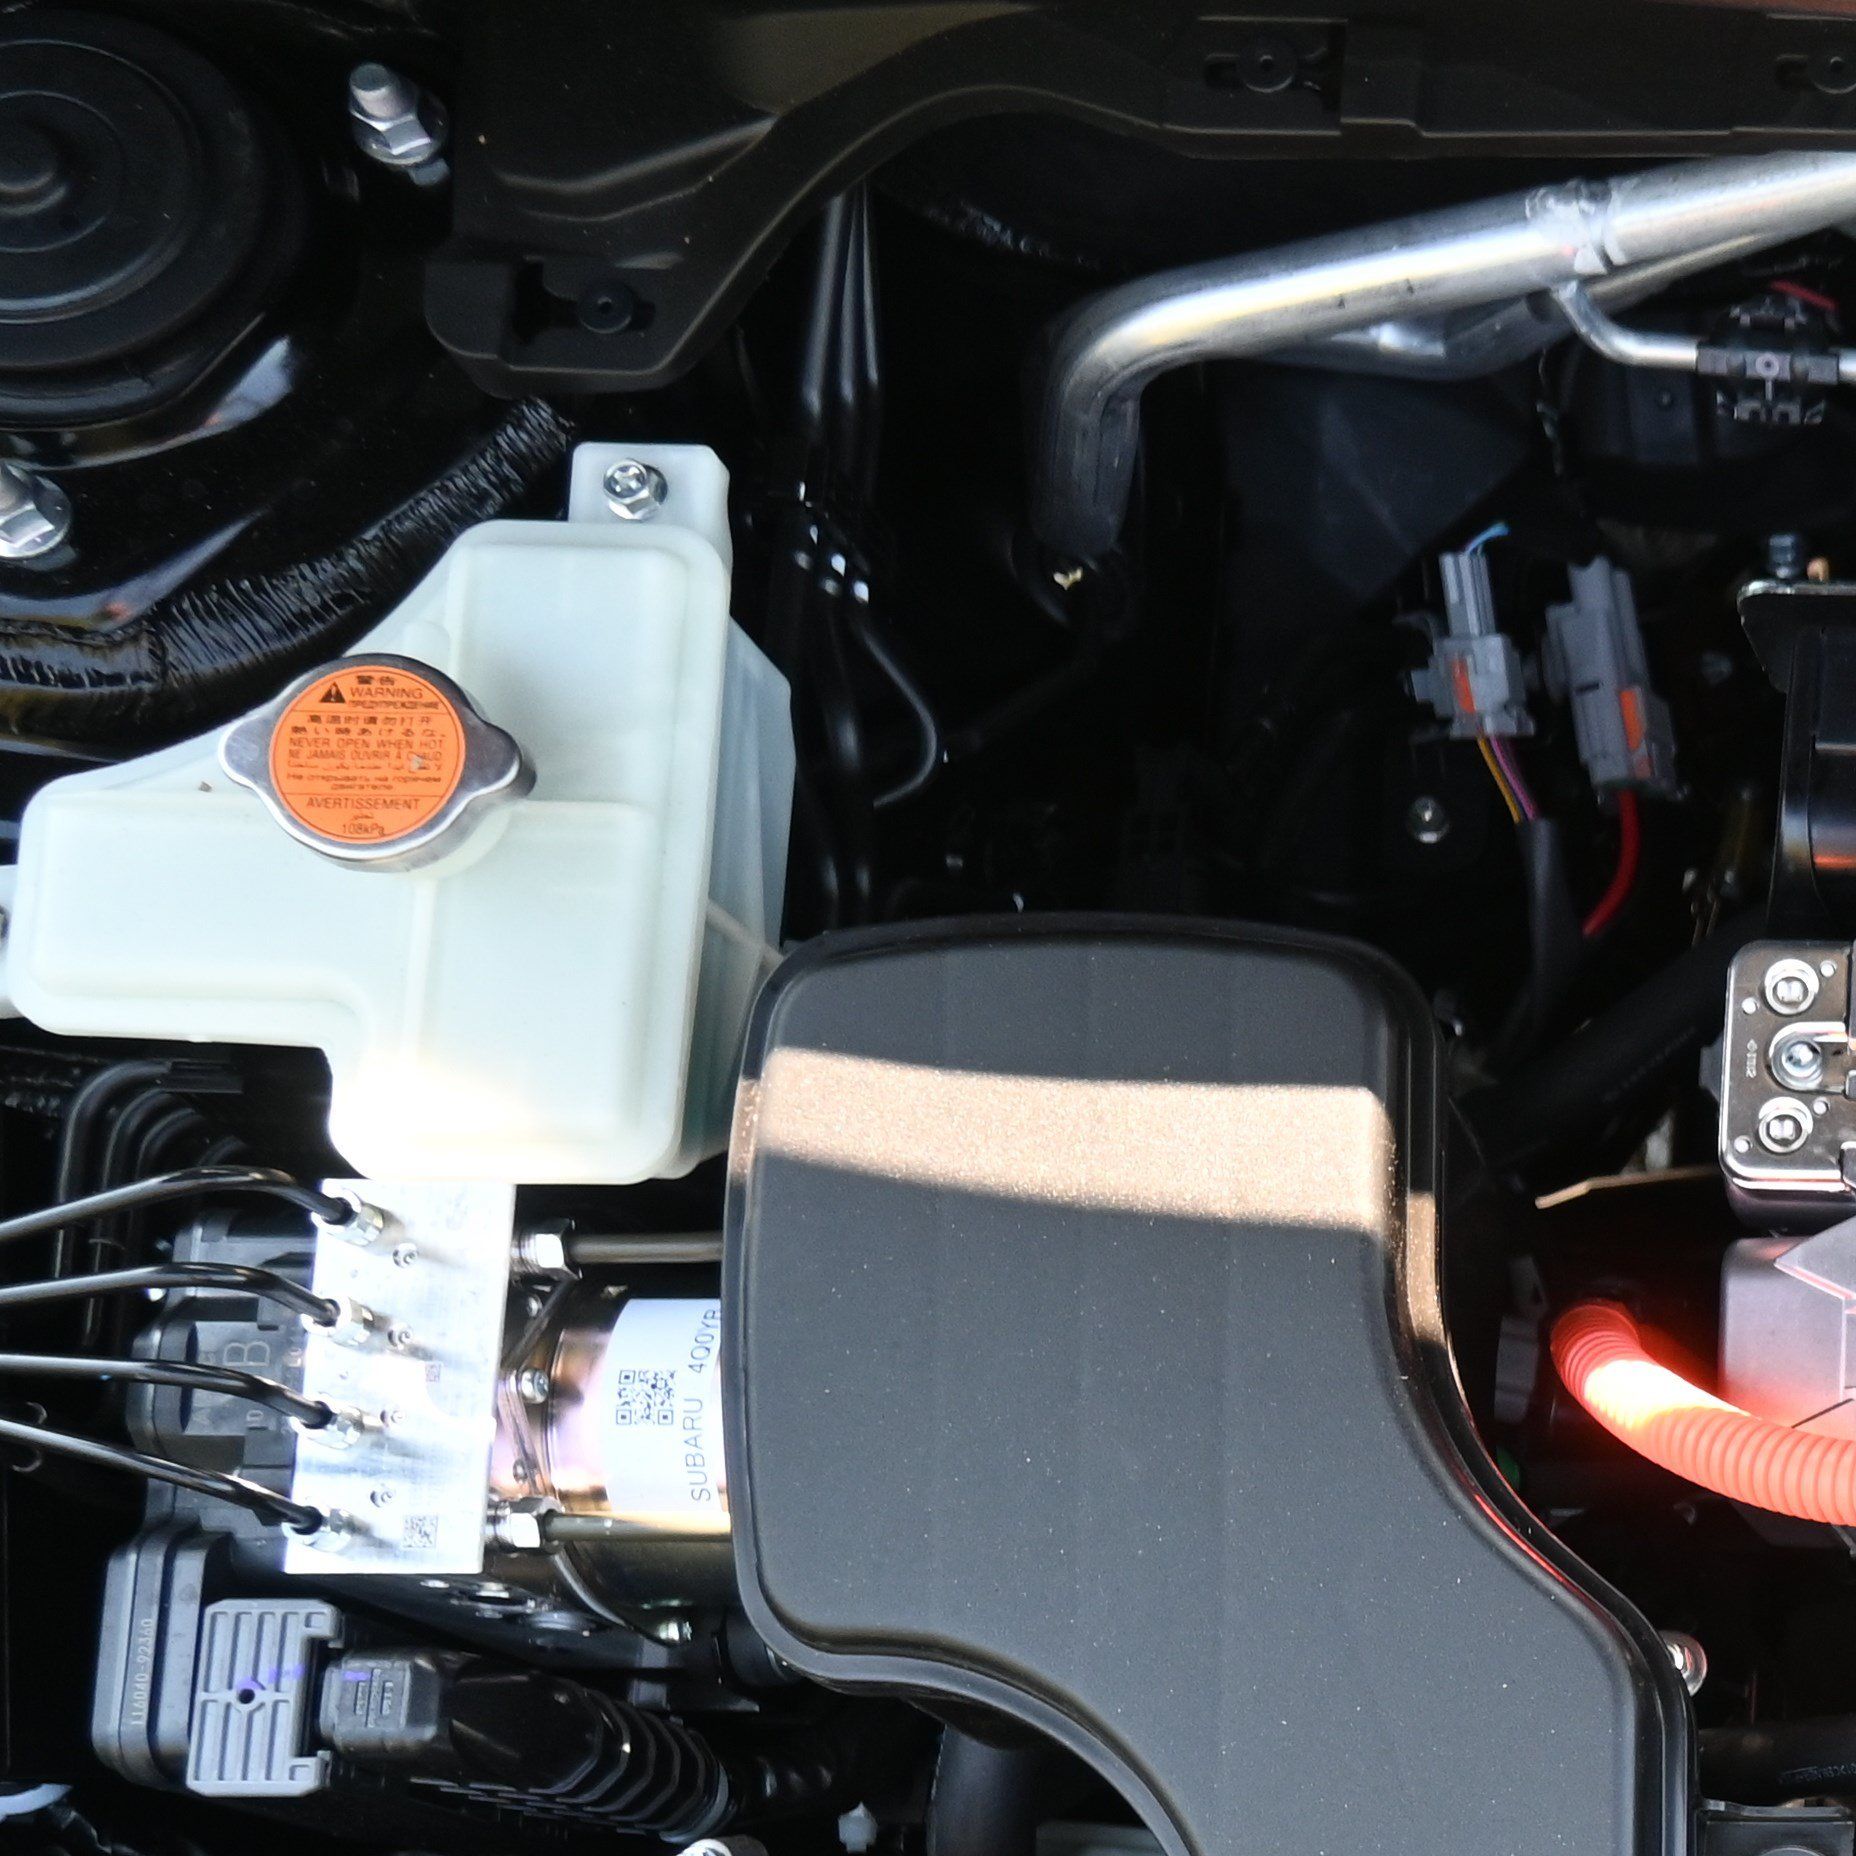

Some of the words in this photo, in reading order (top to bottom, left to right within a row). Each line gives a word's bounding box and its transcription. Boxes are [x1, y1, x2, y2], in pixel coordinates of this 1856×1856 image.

[349, 687, 423, 699] WARNING
[289, 737, 330, 748] NEVER
[336, 738, 369, 748] OPEN
[376, 739, 413, 749] WHEN
[419, 739, 443, 748] HOT
[306, 797, 420, 809] AVERTISSEMENT
[679, 1397, 714, 1501] SUBARU
